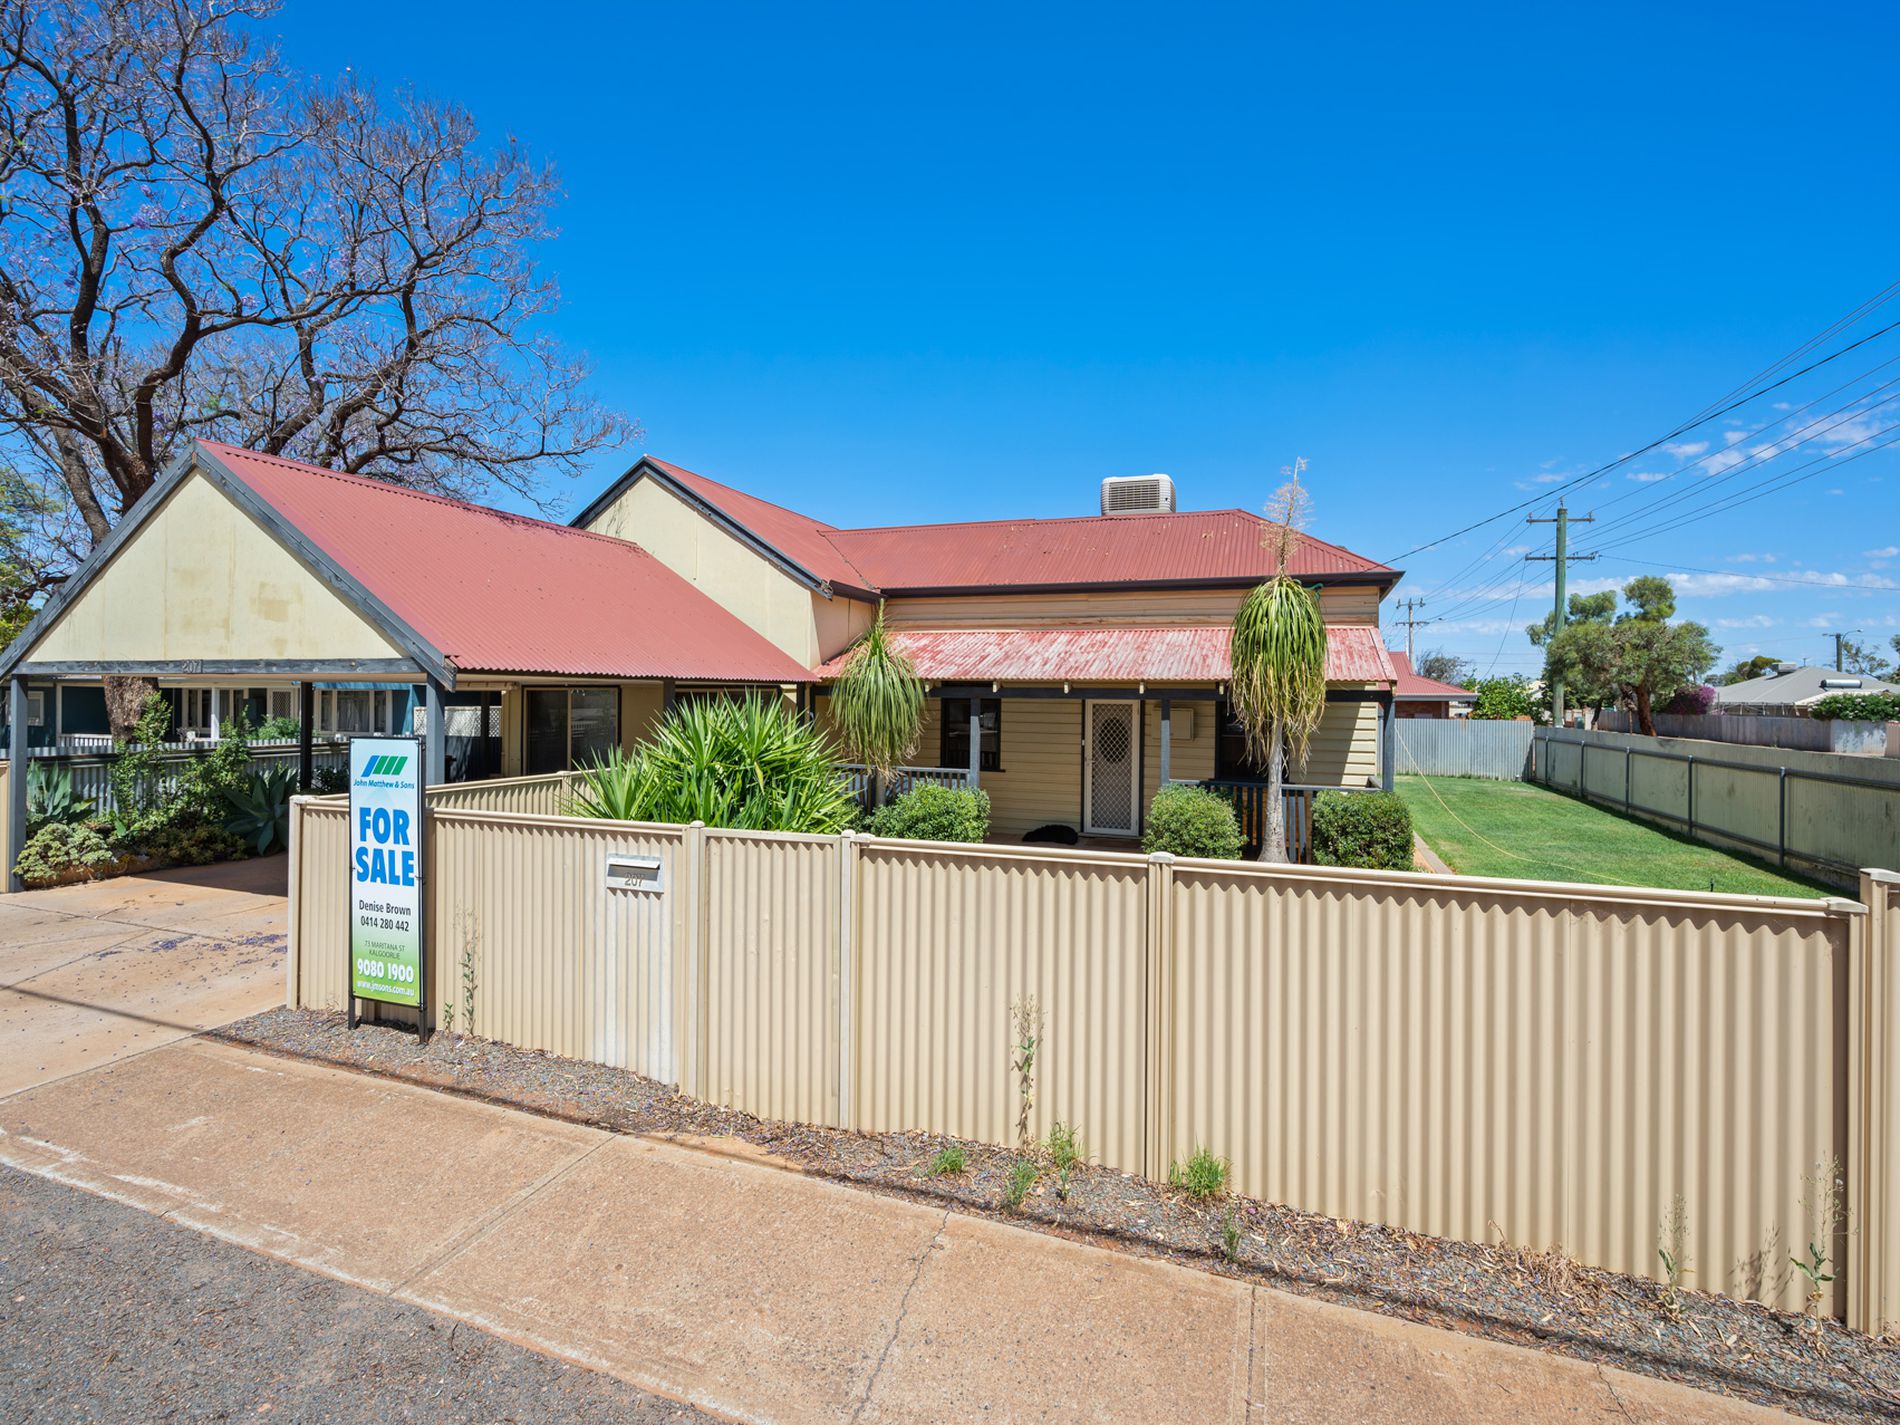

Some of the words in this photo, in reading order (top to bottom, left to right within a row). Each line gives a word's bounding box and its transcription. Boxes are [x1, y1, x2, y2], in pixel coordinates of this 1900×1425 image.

[368, 780, 394, 788] Matthew
[400, 781, 415, 789] Sons
[359, 807, 410, 845] FOR
[355, 846, 415, 886] SALE
[624, 873, 644, 887] 207
[359, 899, 384, 912] Denise
[386, 903, 411, 916] Brown
[360, 915, 378, 928] 0414
[379, 918, 394, 930] 280
[395, 920, 410, 932] 442
[369, 949, 400, 959] KALGOORLIE
[371, 941, 397, 951] MARITANA
[398, 944, 406, 952] ST
[357, 958, 384, 978] 9080
[387, 962, 414, 983] 1900
